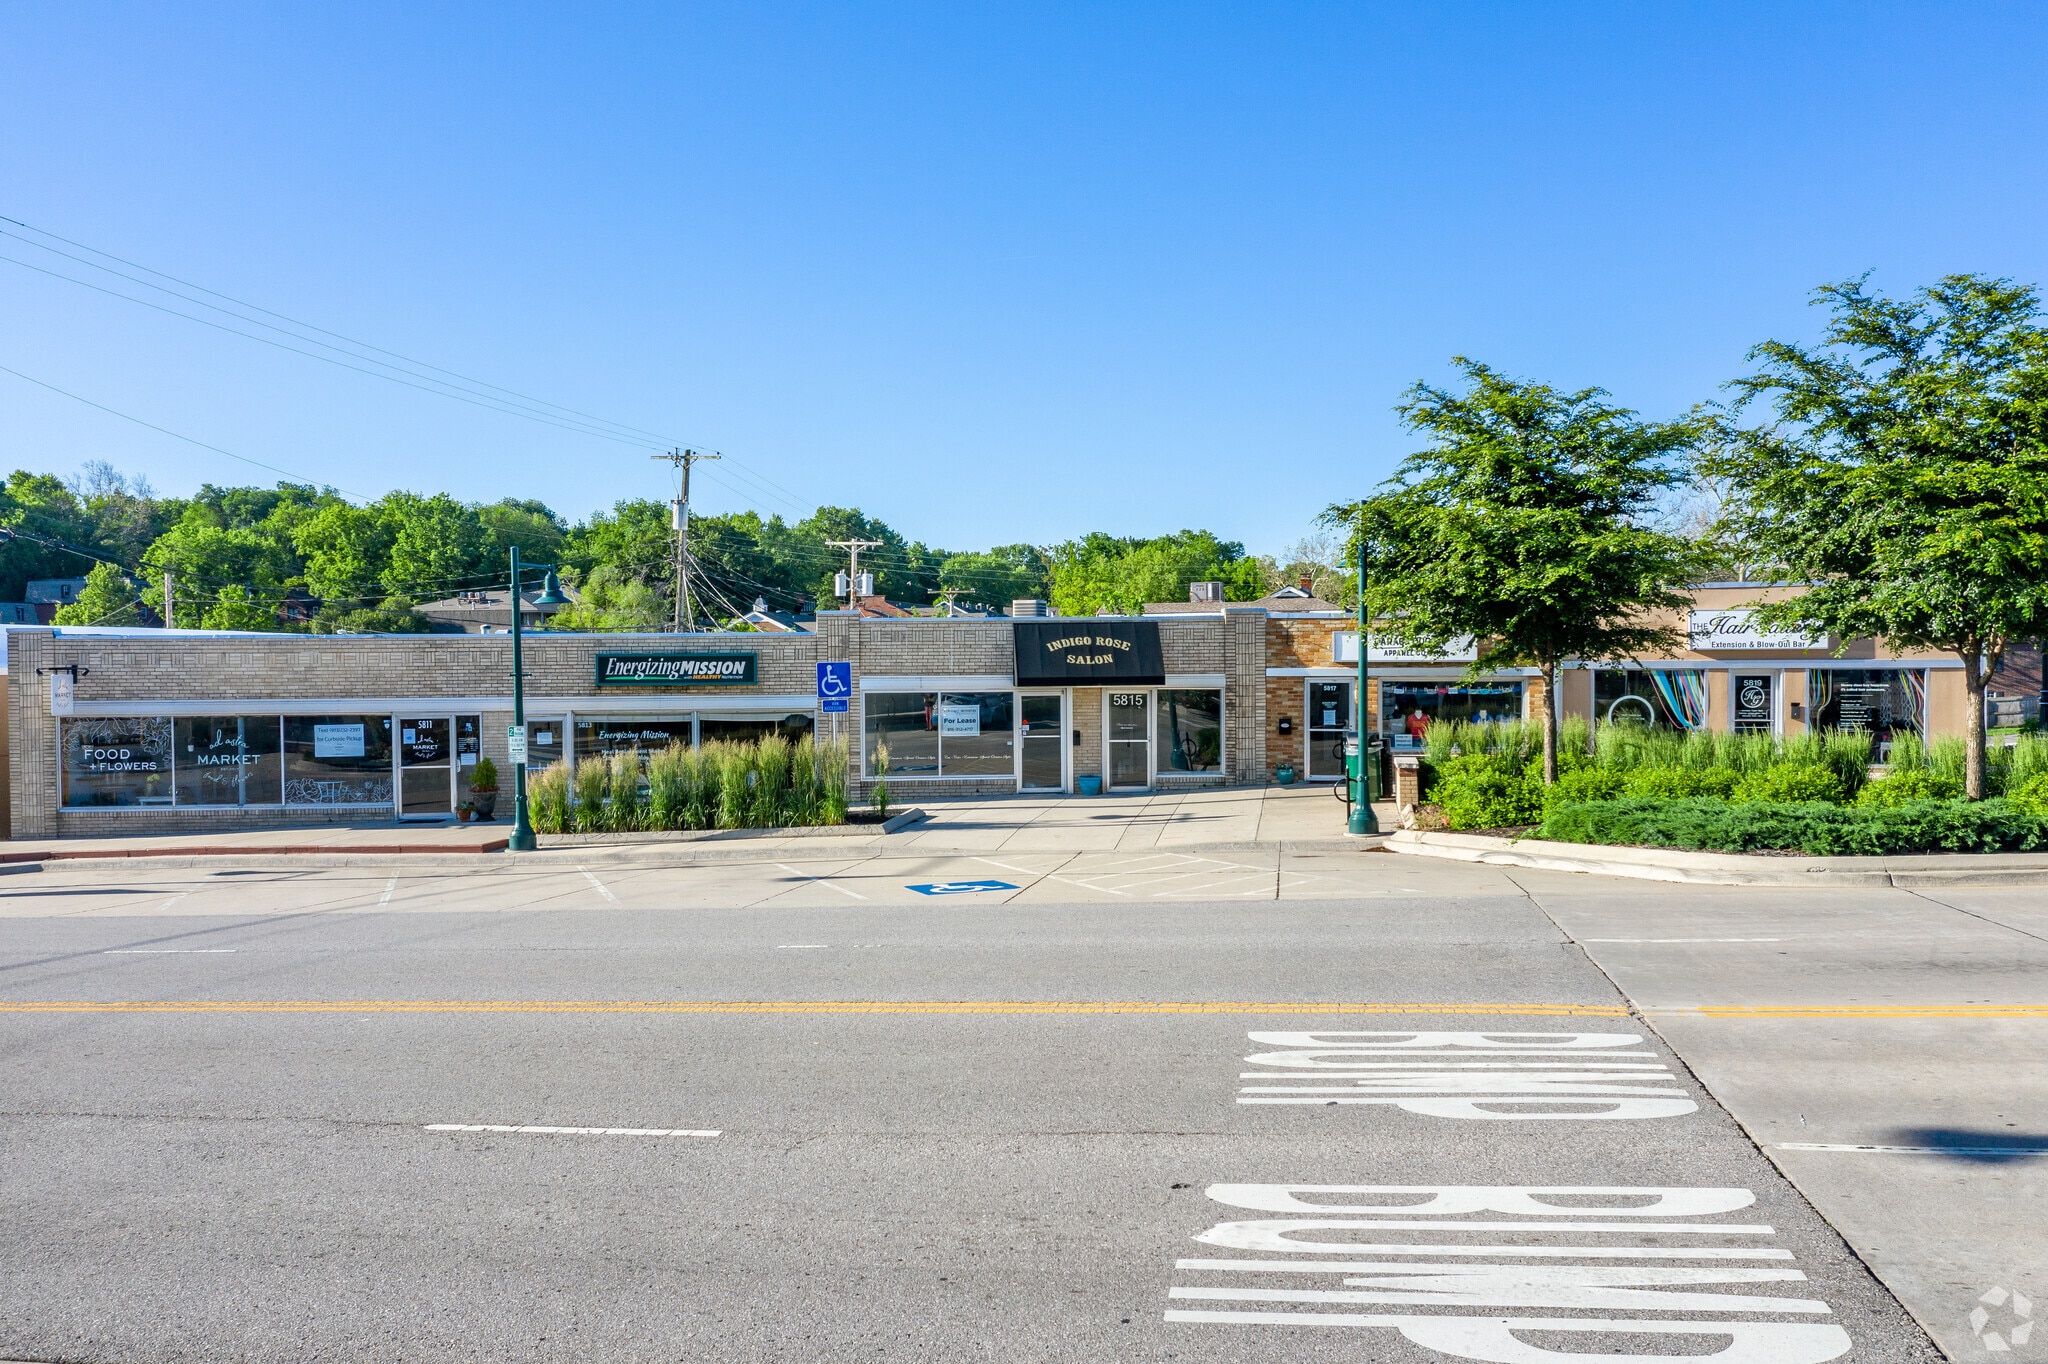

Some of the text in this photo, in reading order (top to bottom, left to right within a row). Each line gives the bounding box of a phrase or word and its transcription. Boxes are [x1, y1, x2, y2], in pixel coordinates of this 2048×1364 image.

[1709, 616, 1753, 635] Hair
[1046, 636, 1131, 652] INDIGO ROSE
[1756, 640, 1791, 648] Blow-Out
[1066, 654, 1114, 665] SALON
[1743, 679, 1763, 687] 5819
[1113, 694, 1143, 706] 5815
[418, 720, 433, 729] 5811
[509, 727, 515, 736] 2
[598, 730, 670, 742] Energizing Mission
[225, 734, 251, 749] astra
[84, 749, 131, 760] FOOD
[197, 754, 261, 765] MARKET
[99, 761, 157, 771] FLOWERS
[1236, 1030, 1700, 1121] BUMP
[1163, 1183, 1853, 1364] BUMP
